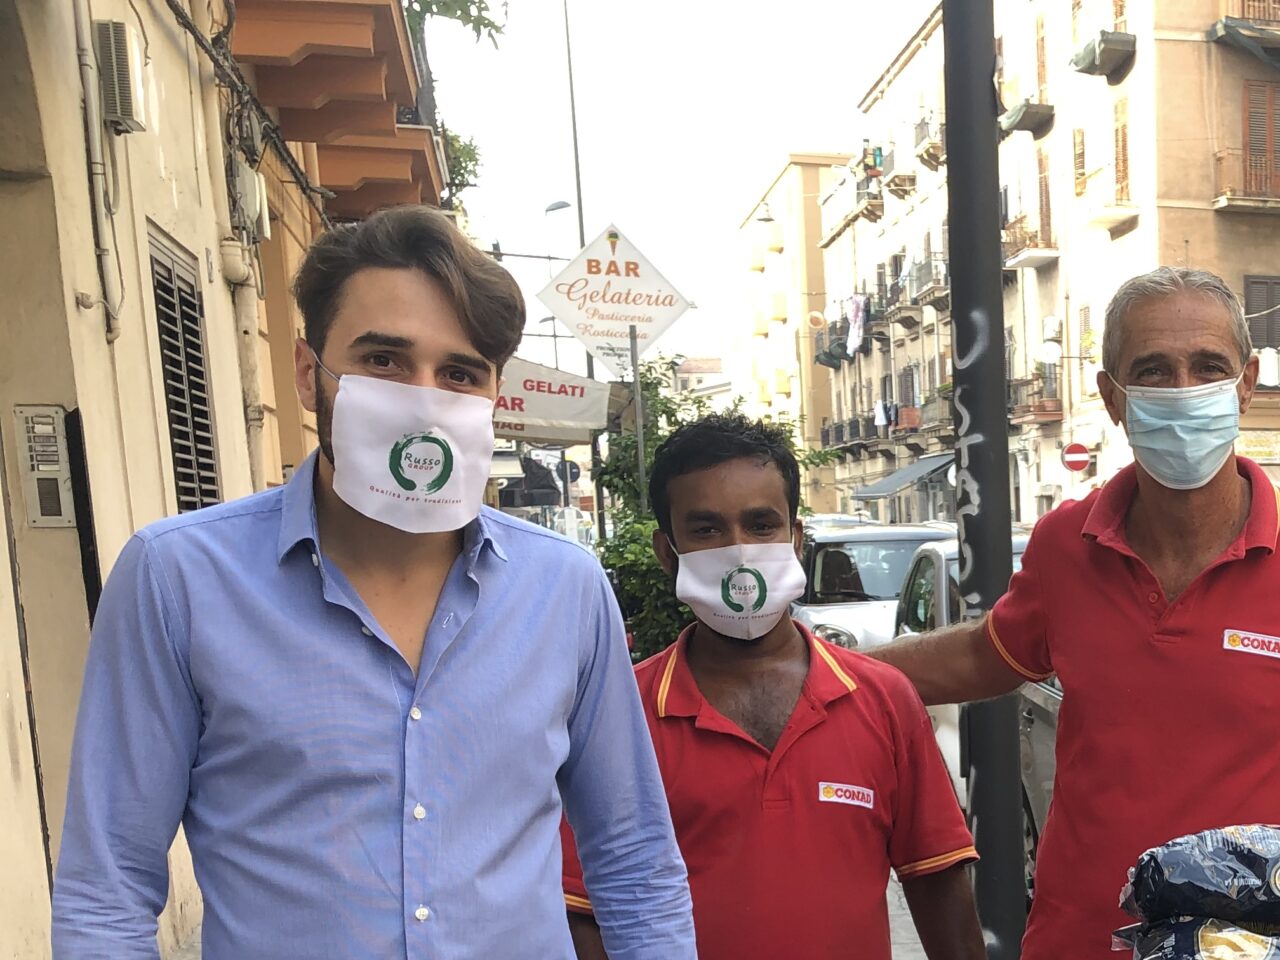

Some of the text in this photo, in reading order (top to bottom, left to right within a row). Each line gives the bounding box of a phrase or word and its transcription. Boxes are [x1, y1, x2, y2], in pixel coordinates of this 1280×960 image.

[586, 259, 640, 278] BAR
[555, 278, 679, 310] Gelateria
[585, 308, 653, 323] Pasticceria
[576, 323, 649, 339] Rosticceia
[523, 379, 585, 398] GELATI
[494, 396, 525, 412] AR
[404, 452, 441, 467] Russo
[407, 463, 434, 471] GROUP
[731, 583, 757, 591] Russo
[834, 788, 871, 803] CONAD
